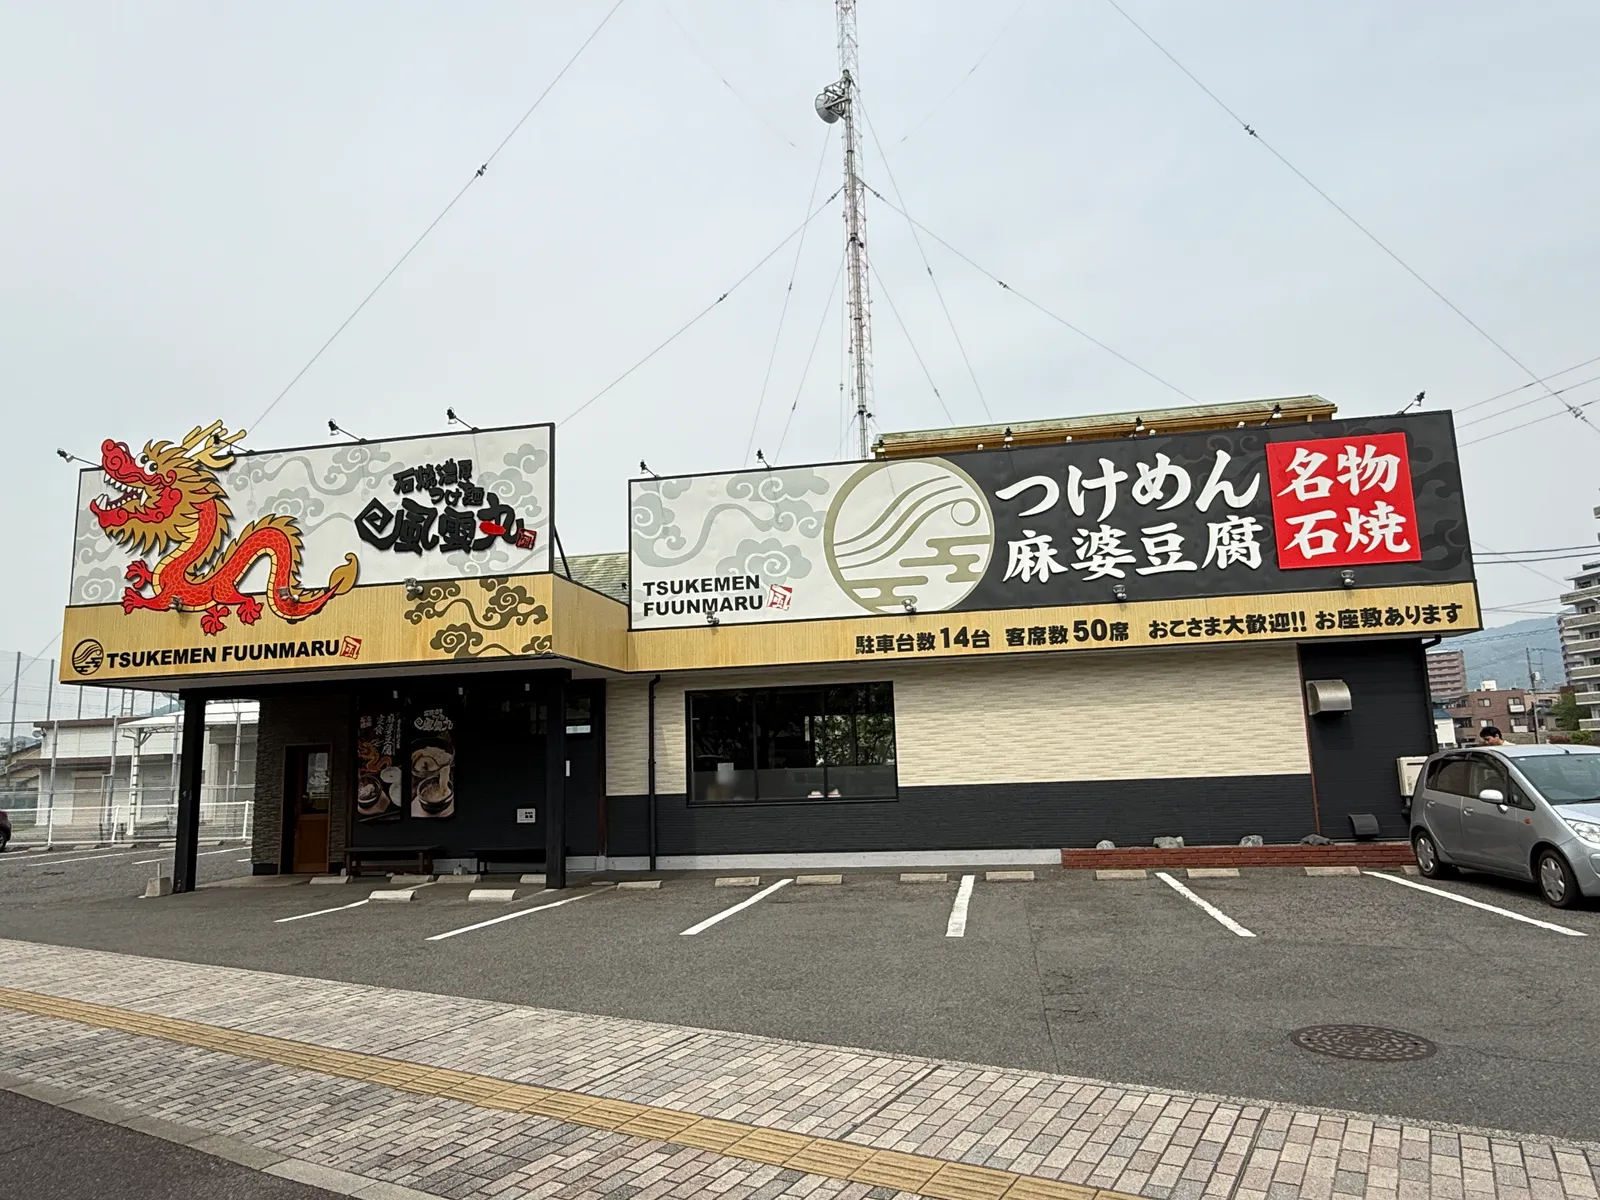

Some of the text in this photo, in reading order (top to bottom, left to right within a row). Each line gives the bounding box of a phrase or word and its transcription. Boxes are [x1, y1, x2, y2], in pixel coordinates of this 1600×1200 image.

[393, 458, 473, 495] 石焼濃厚
[995, 449, 1261, 523] つけめん
[1276, 444, 1402, 503] 名物
[1002, 515, 1265, 585] 麻婆豆腐
[1278, 501, 1412, 560] 石焼
[642, 574, 761, 597] TSUKEMEN
[643, 594, 764, 617] FUUNMARU
[106, 639, 340, 669] TSUKEMEN FUUNMARU
[855, 602, 1464, 655] 駐車台数14台 客席数50席 おこさま大歓迎!! お座敷あります
